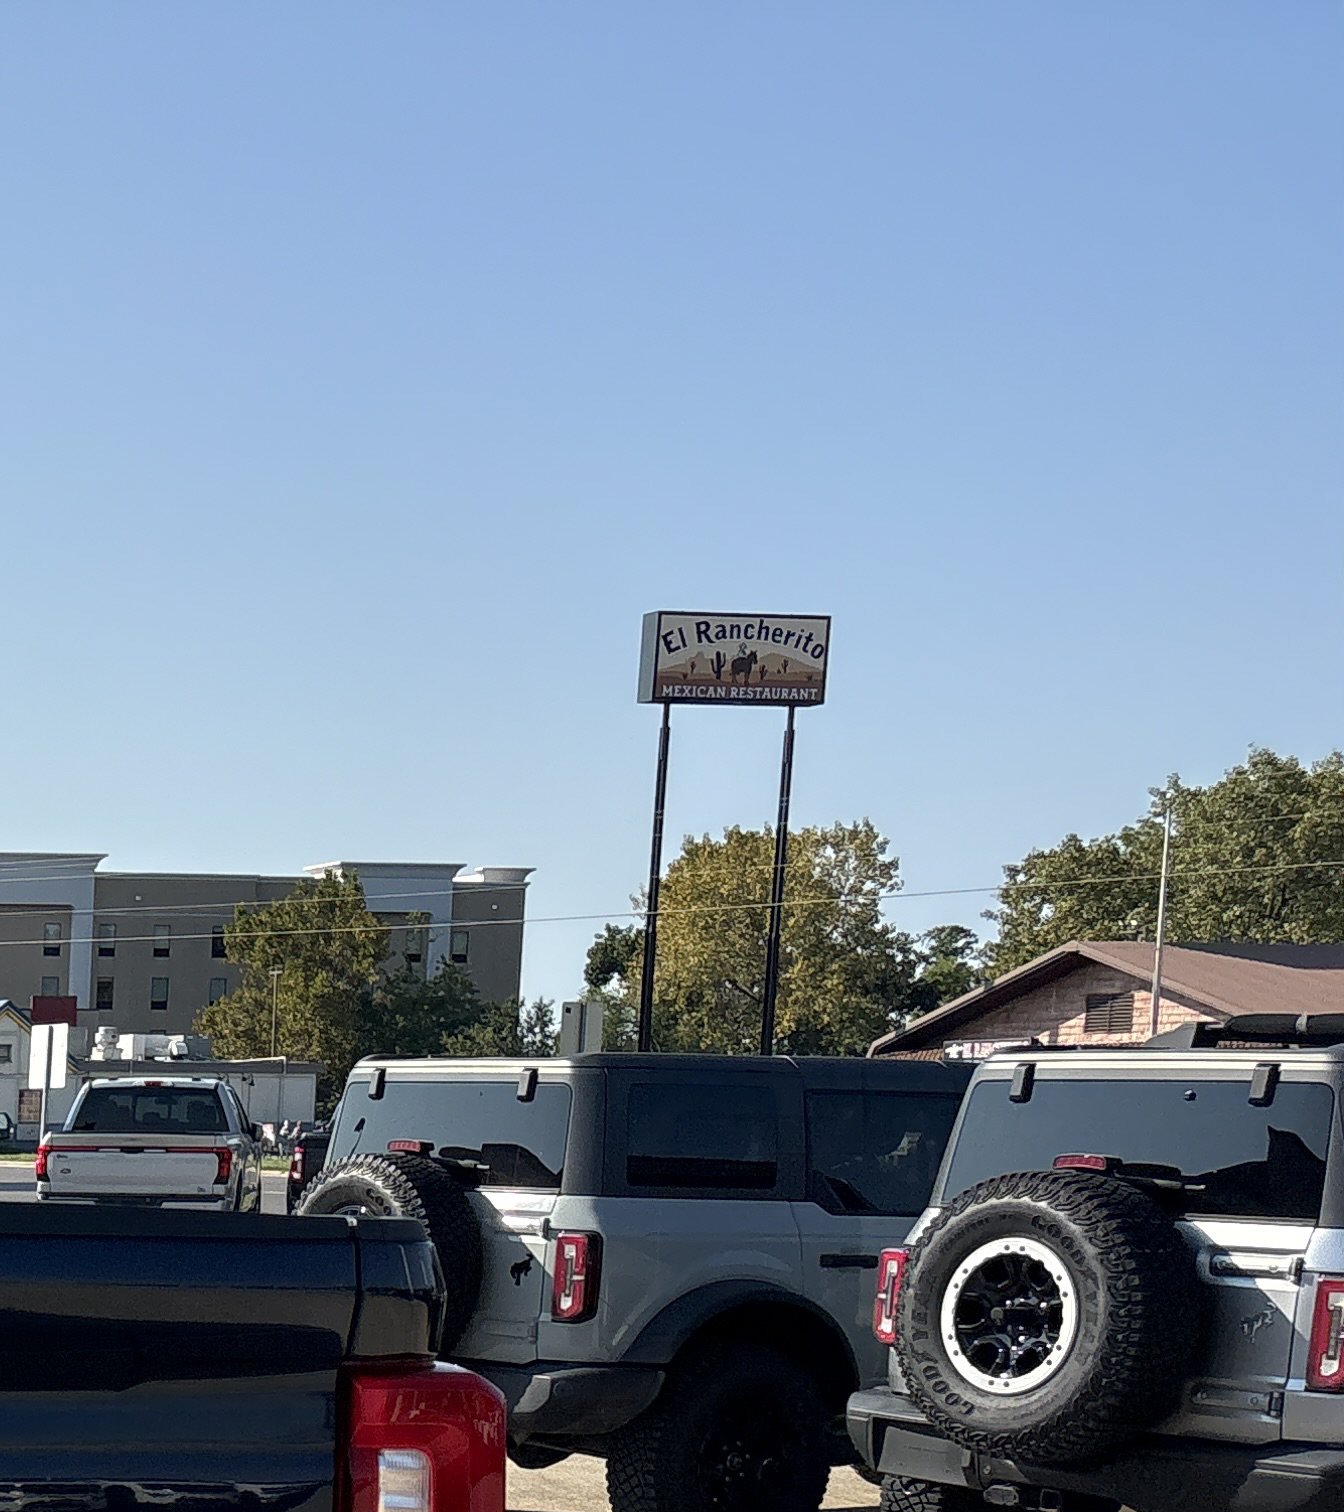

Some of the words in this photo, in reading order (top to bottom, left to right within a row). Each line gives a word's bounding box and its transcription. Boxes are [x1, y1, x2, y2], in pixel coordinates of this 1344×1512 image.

[661, 626, 688, 655] El
[695, 618, 825, 660] Rancherito
[662, 684, 727, 698] MEXICAN
[729, 686, 818, 701] RESTAURANT
